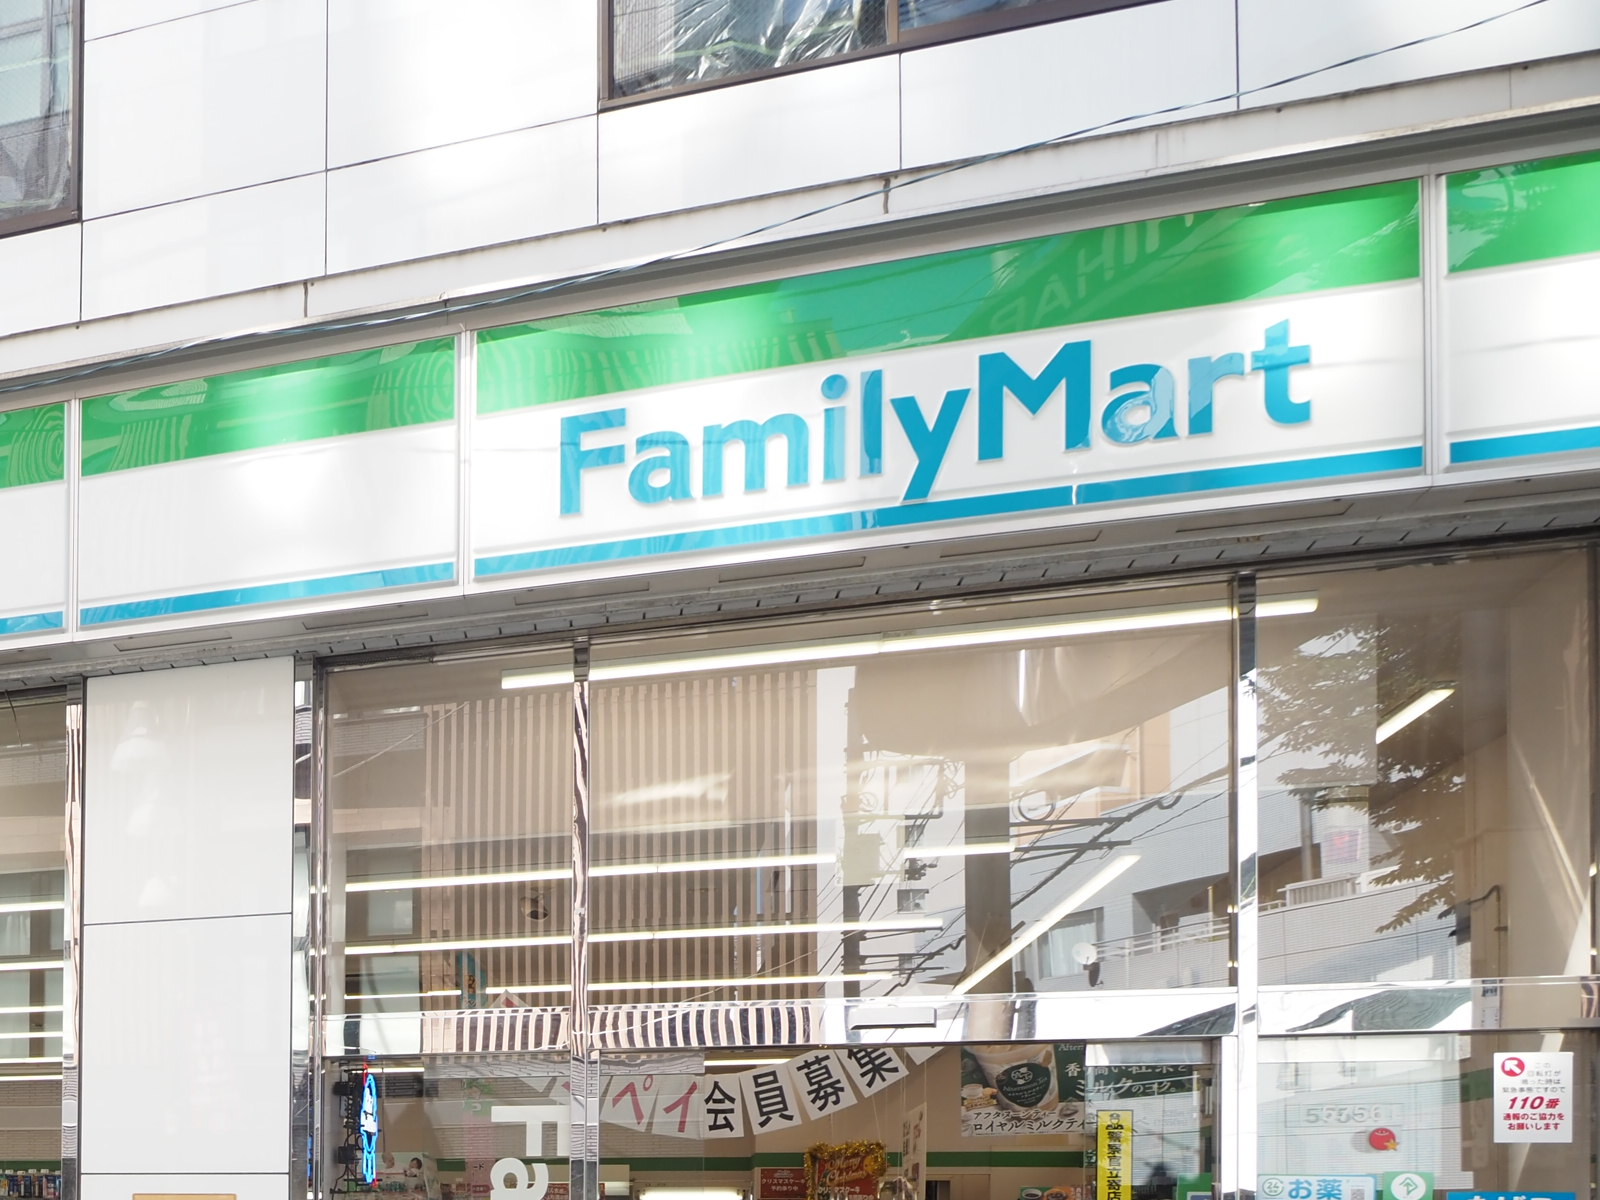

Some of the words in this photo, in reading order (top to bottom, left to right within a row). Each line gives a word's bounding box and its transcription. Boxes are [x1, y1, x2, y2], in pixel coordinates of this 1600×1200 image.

[559, 318, 1311, 515] FamilyMart
[1508, 1096, 1560, 1110] 110番
[1503, 1113, 1565, 1121] 通報のご協力を
[1508, 1123, 1560, 1131] お願いします
[1288, 1178, 1343, 1200] お薬
